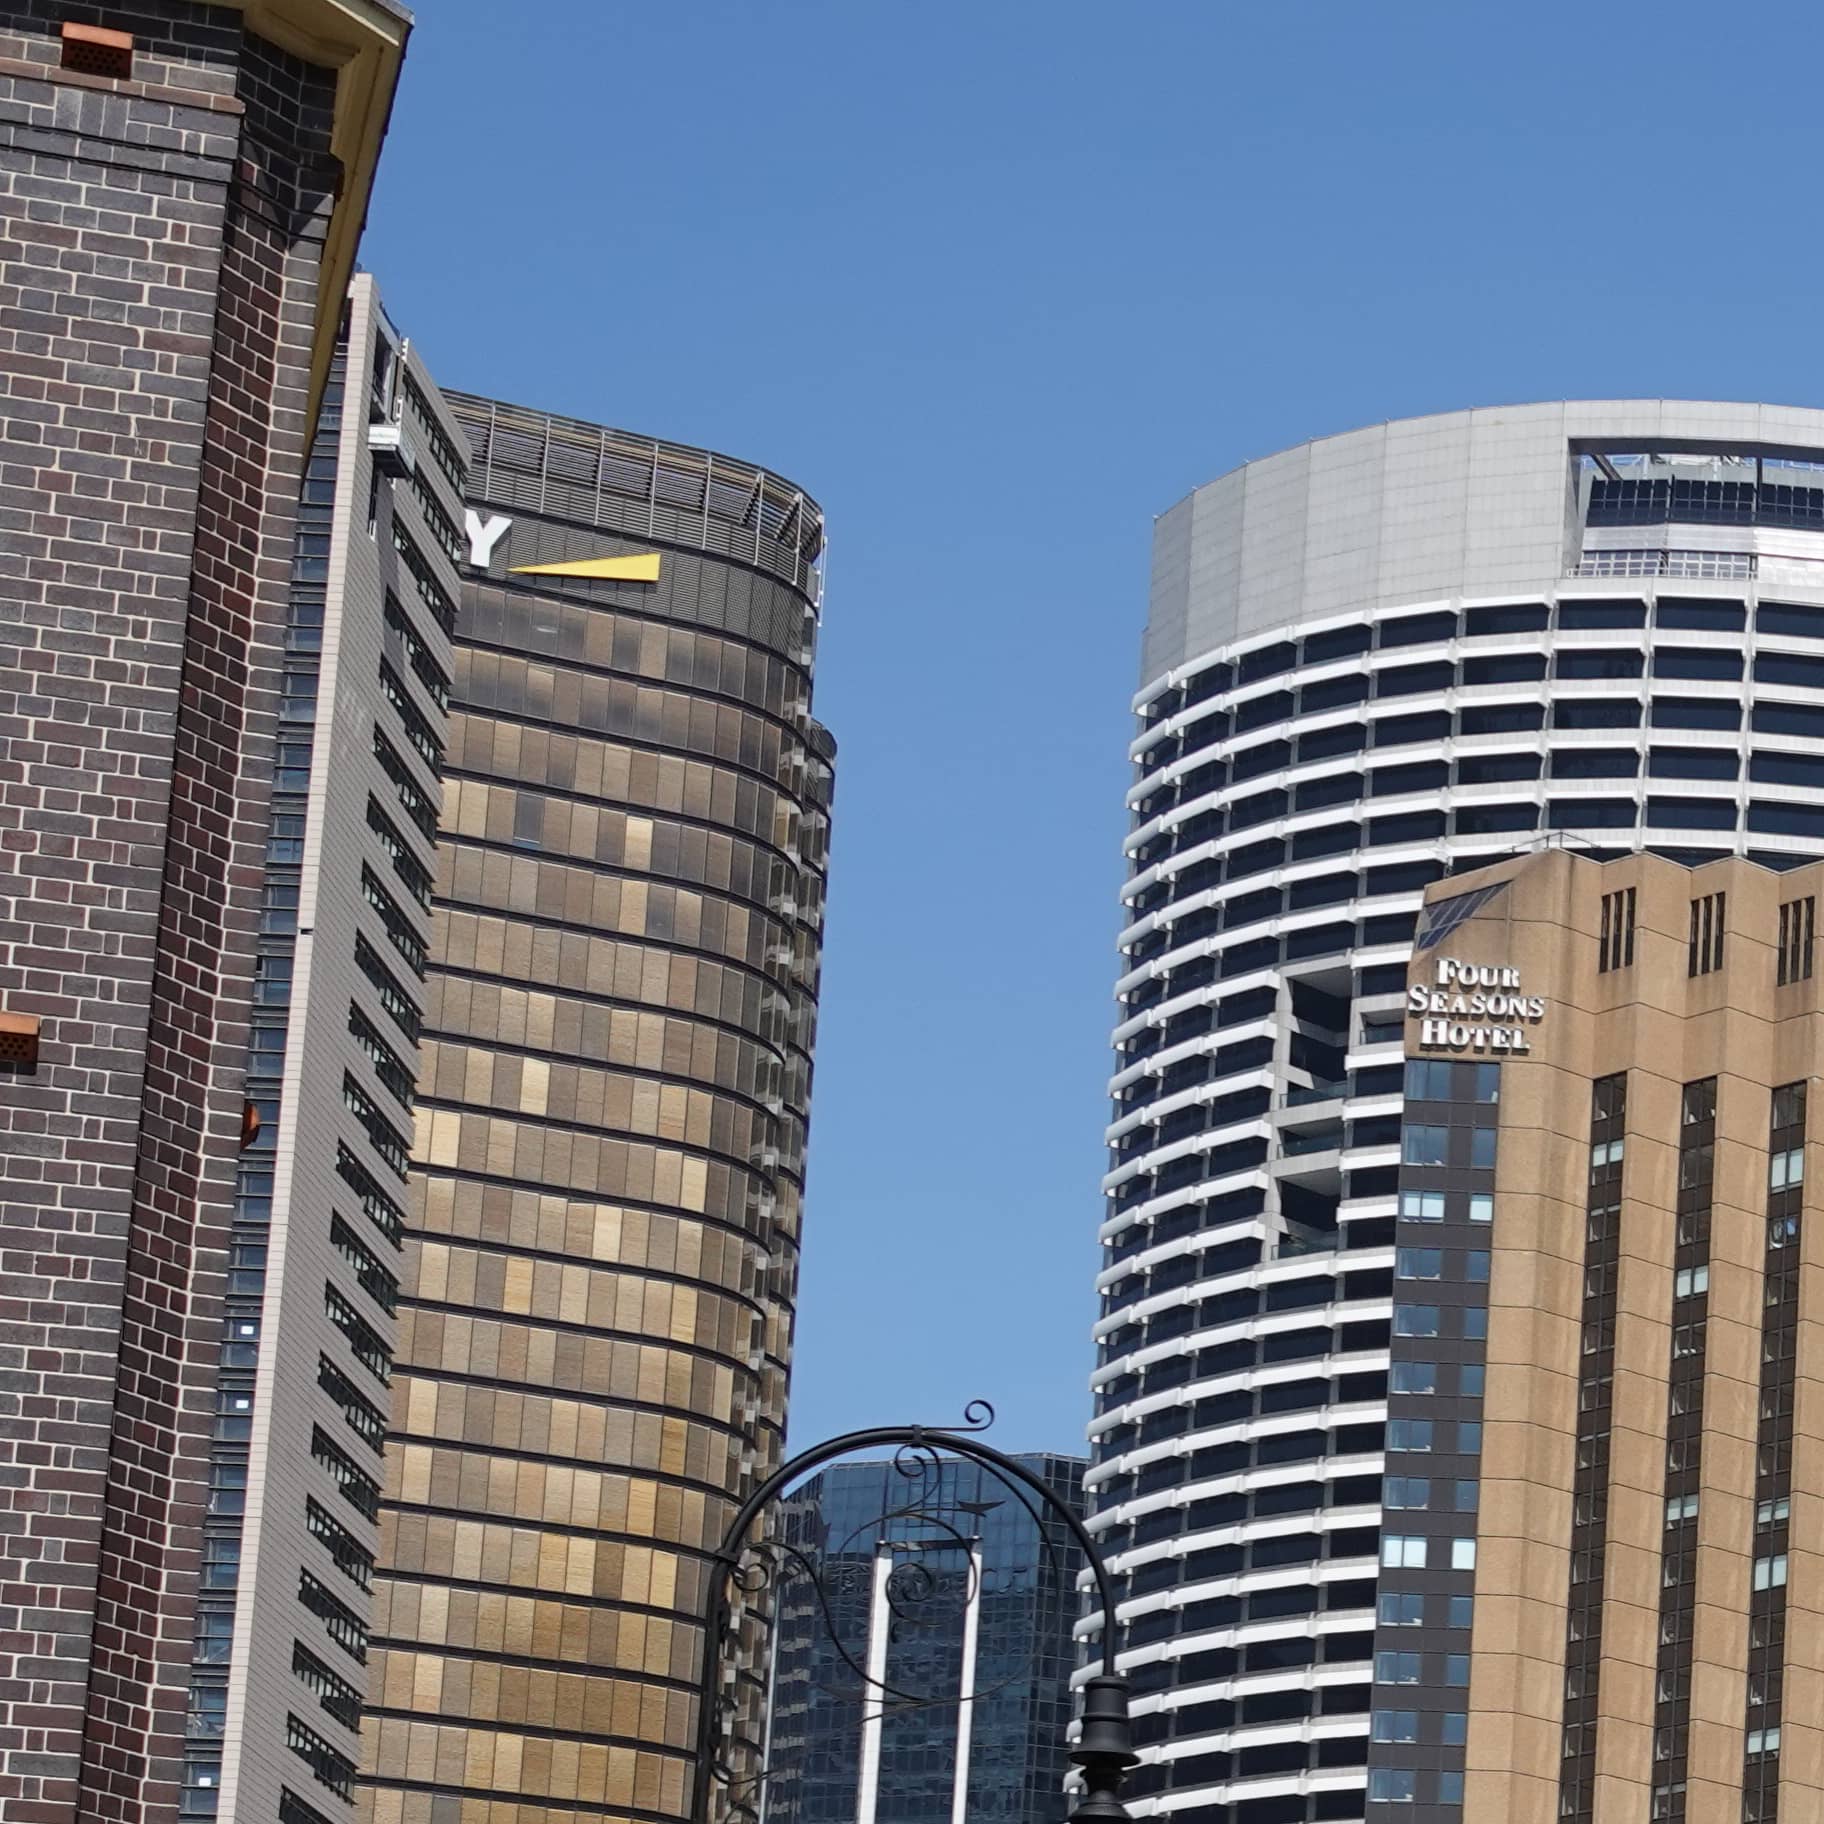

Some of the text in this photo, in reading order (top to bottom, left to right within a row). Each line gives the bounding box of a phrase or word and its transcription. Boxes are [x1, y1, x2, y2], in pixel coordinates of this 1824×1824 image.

[1436, 957, 1520, 988] FOUR
[1407, 983, 1545, 1018] SEASONS
[1420, 1018, 1531, 1050] HOTEL
